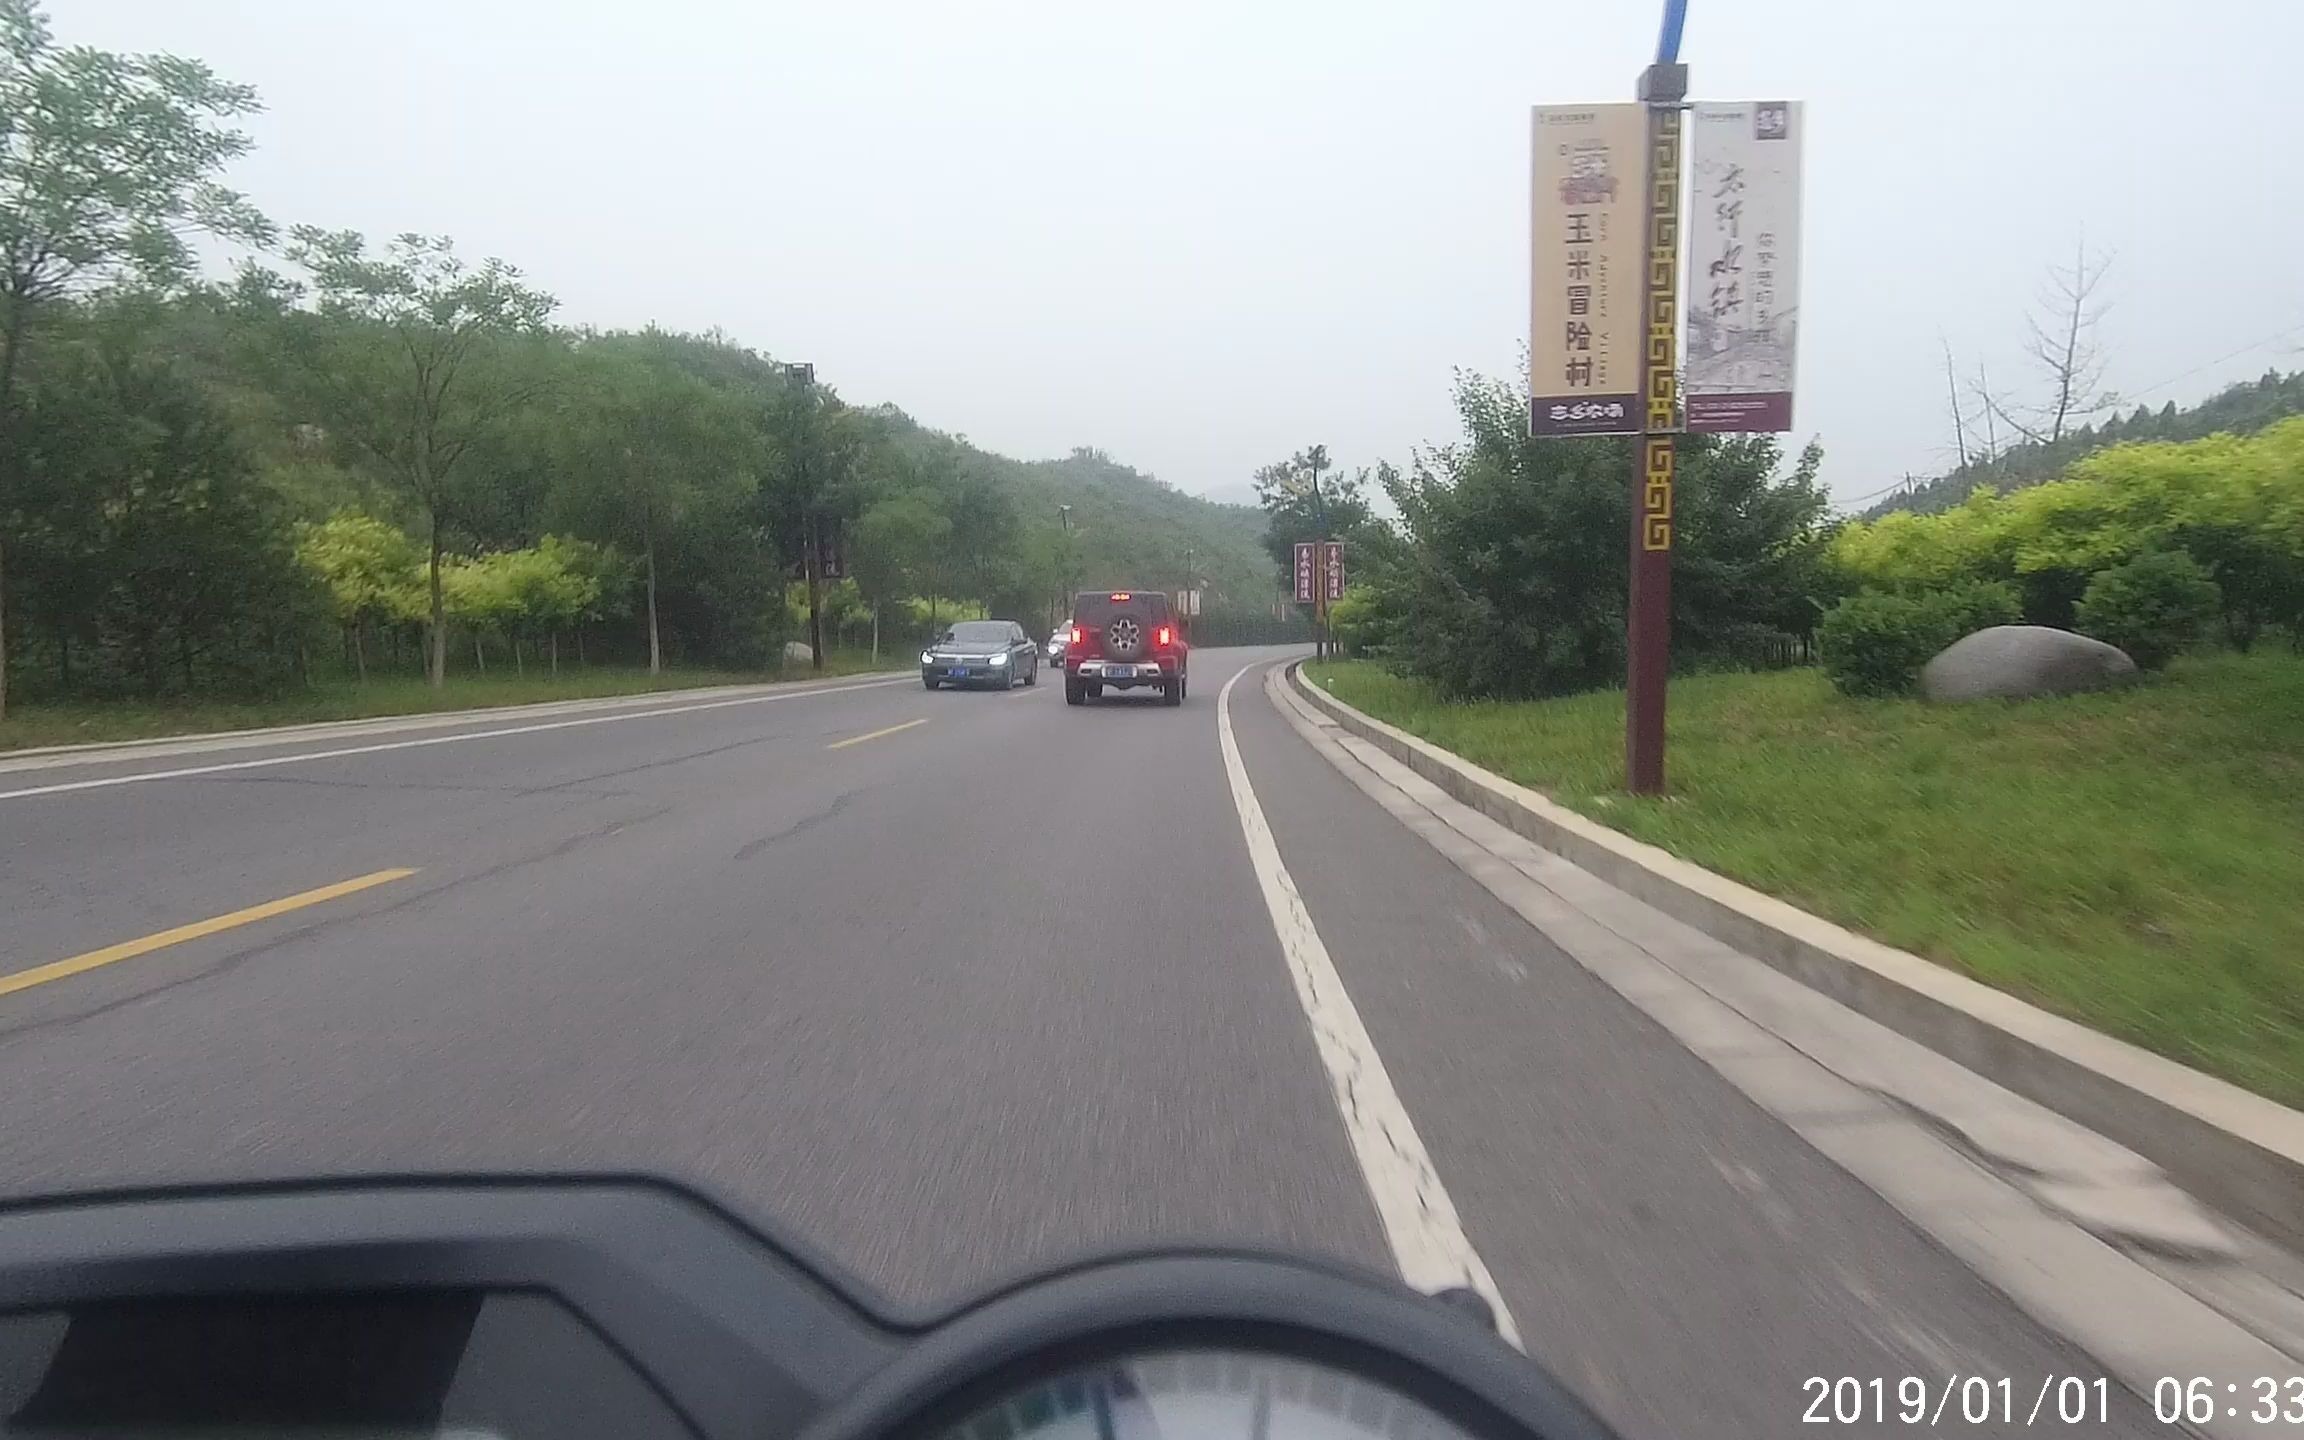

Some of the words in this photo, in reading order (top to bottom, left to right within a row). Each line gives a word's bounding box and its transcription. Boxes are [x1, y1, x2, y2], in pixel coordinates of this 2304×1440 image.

[1565, 213, 1594, 388] 玉米冒险村
